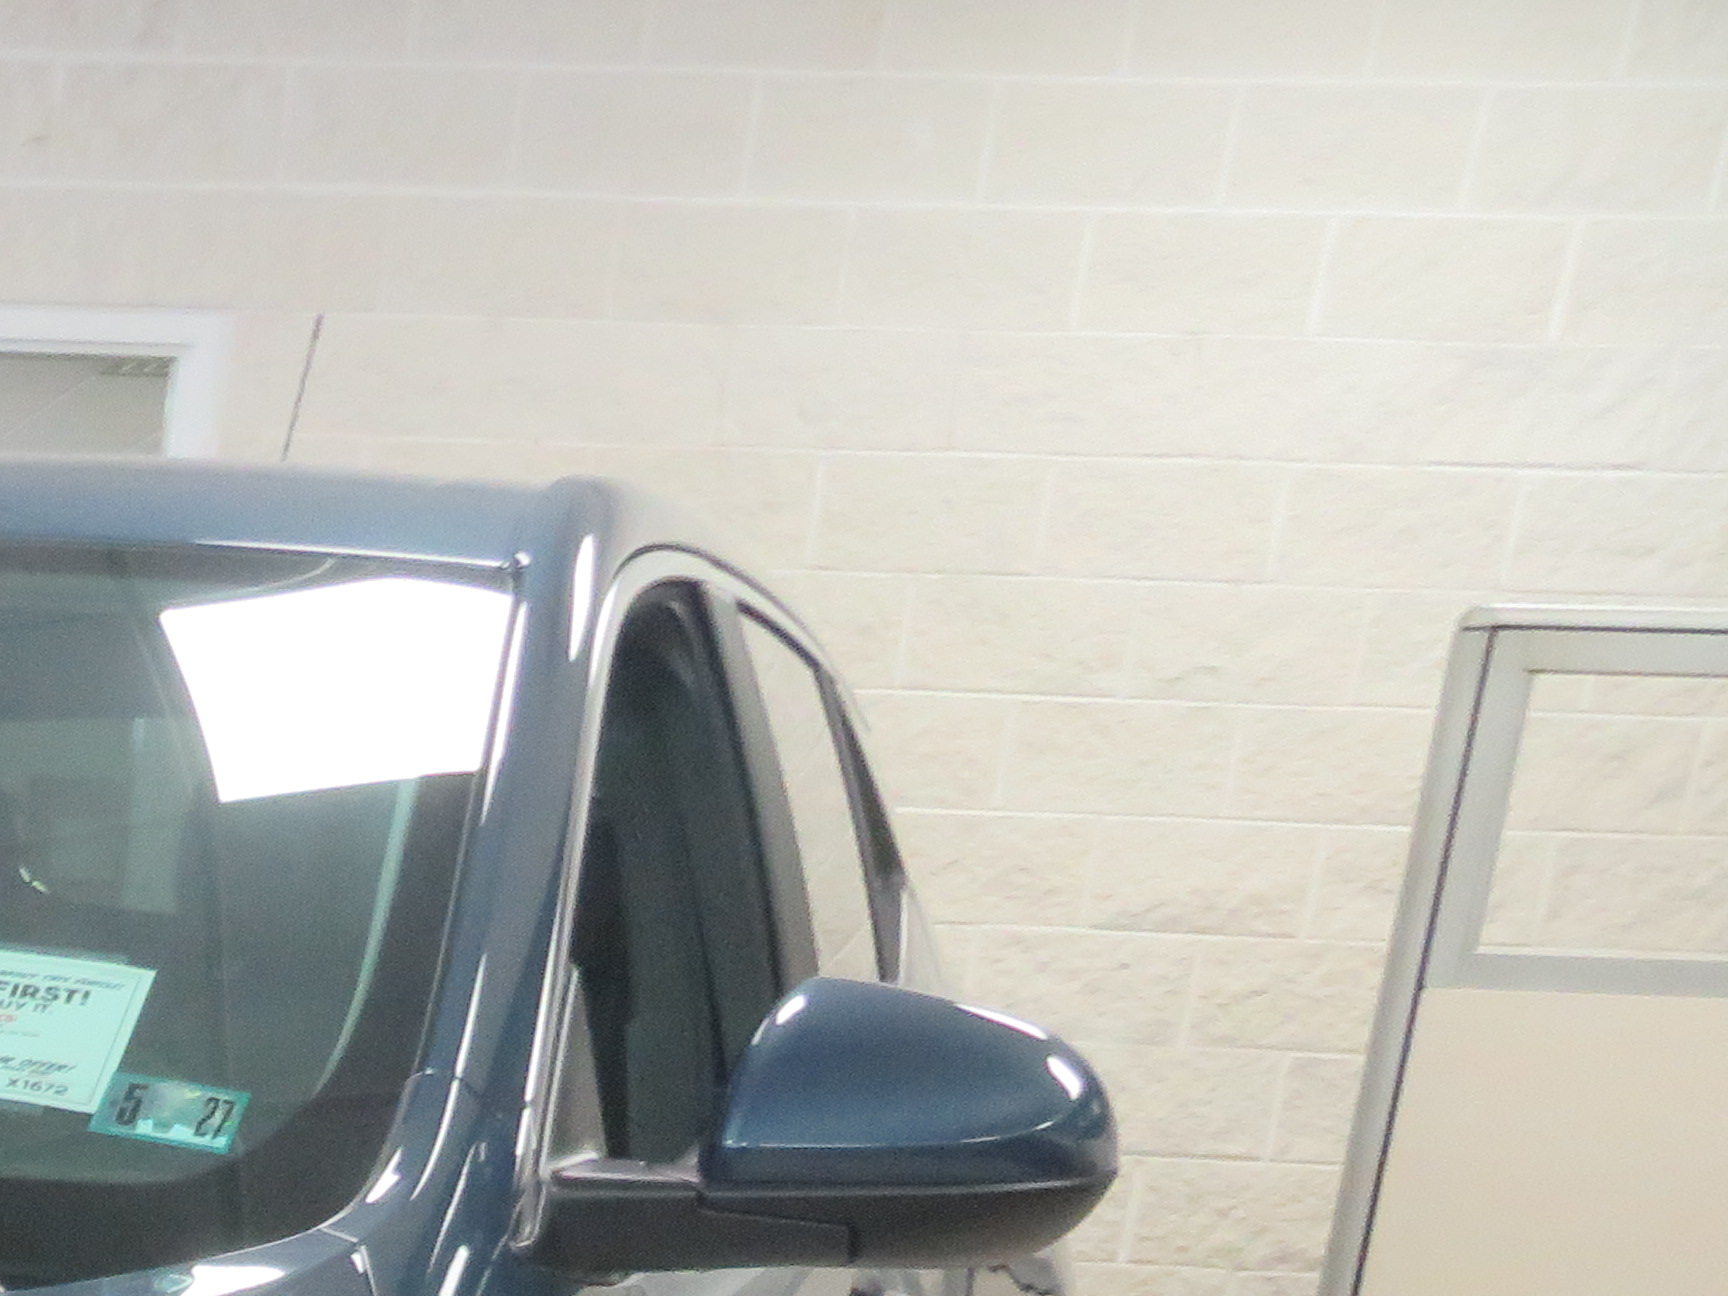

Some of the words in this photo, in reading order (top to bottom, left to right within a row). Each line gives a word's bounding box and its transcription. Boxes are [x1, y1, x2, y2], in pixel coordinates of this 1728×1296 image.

[5, 1077, 70, 1097] X1672
[115, 1083, 148, 1126] 5
[194, 1097, 236, 1140] 27
